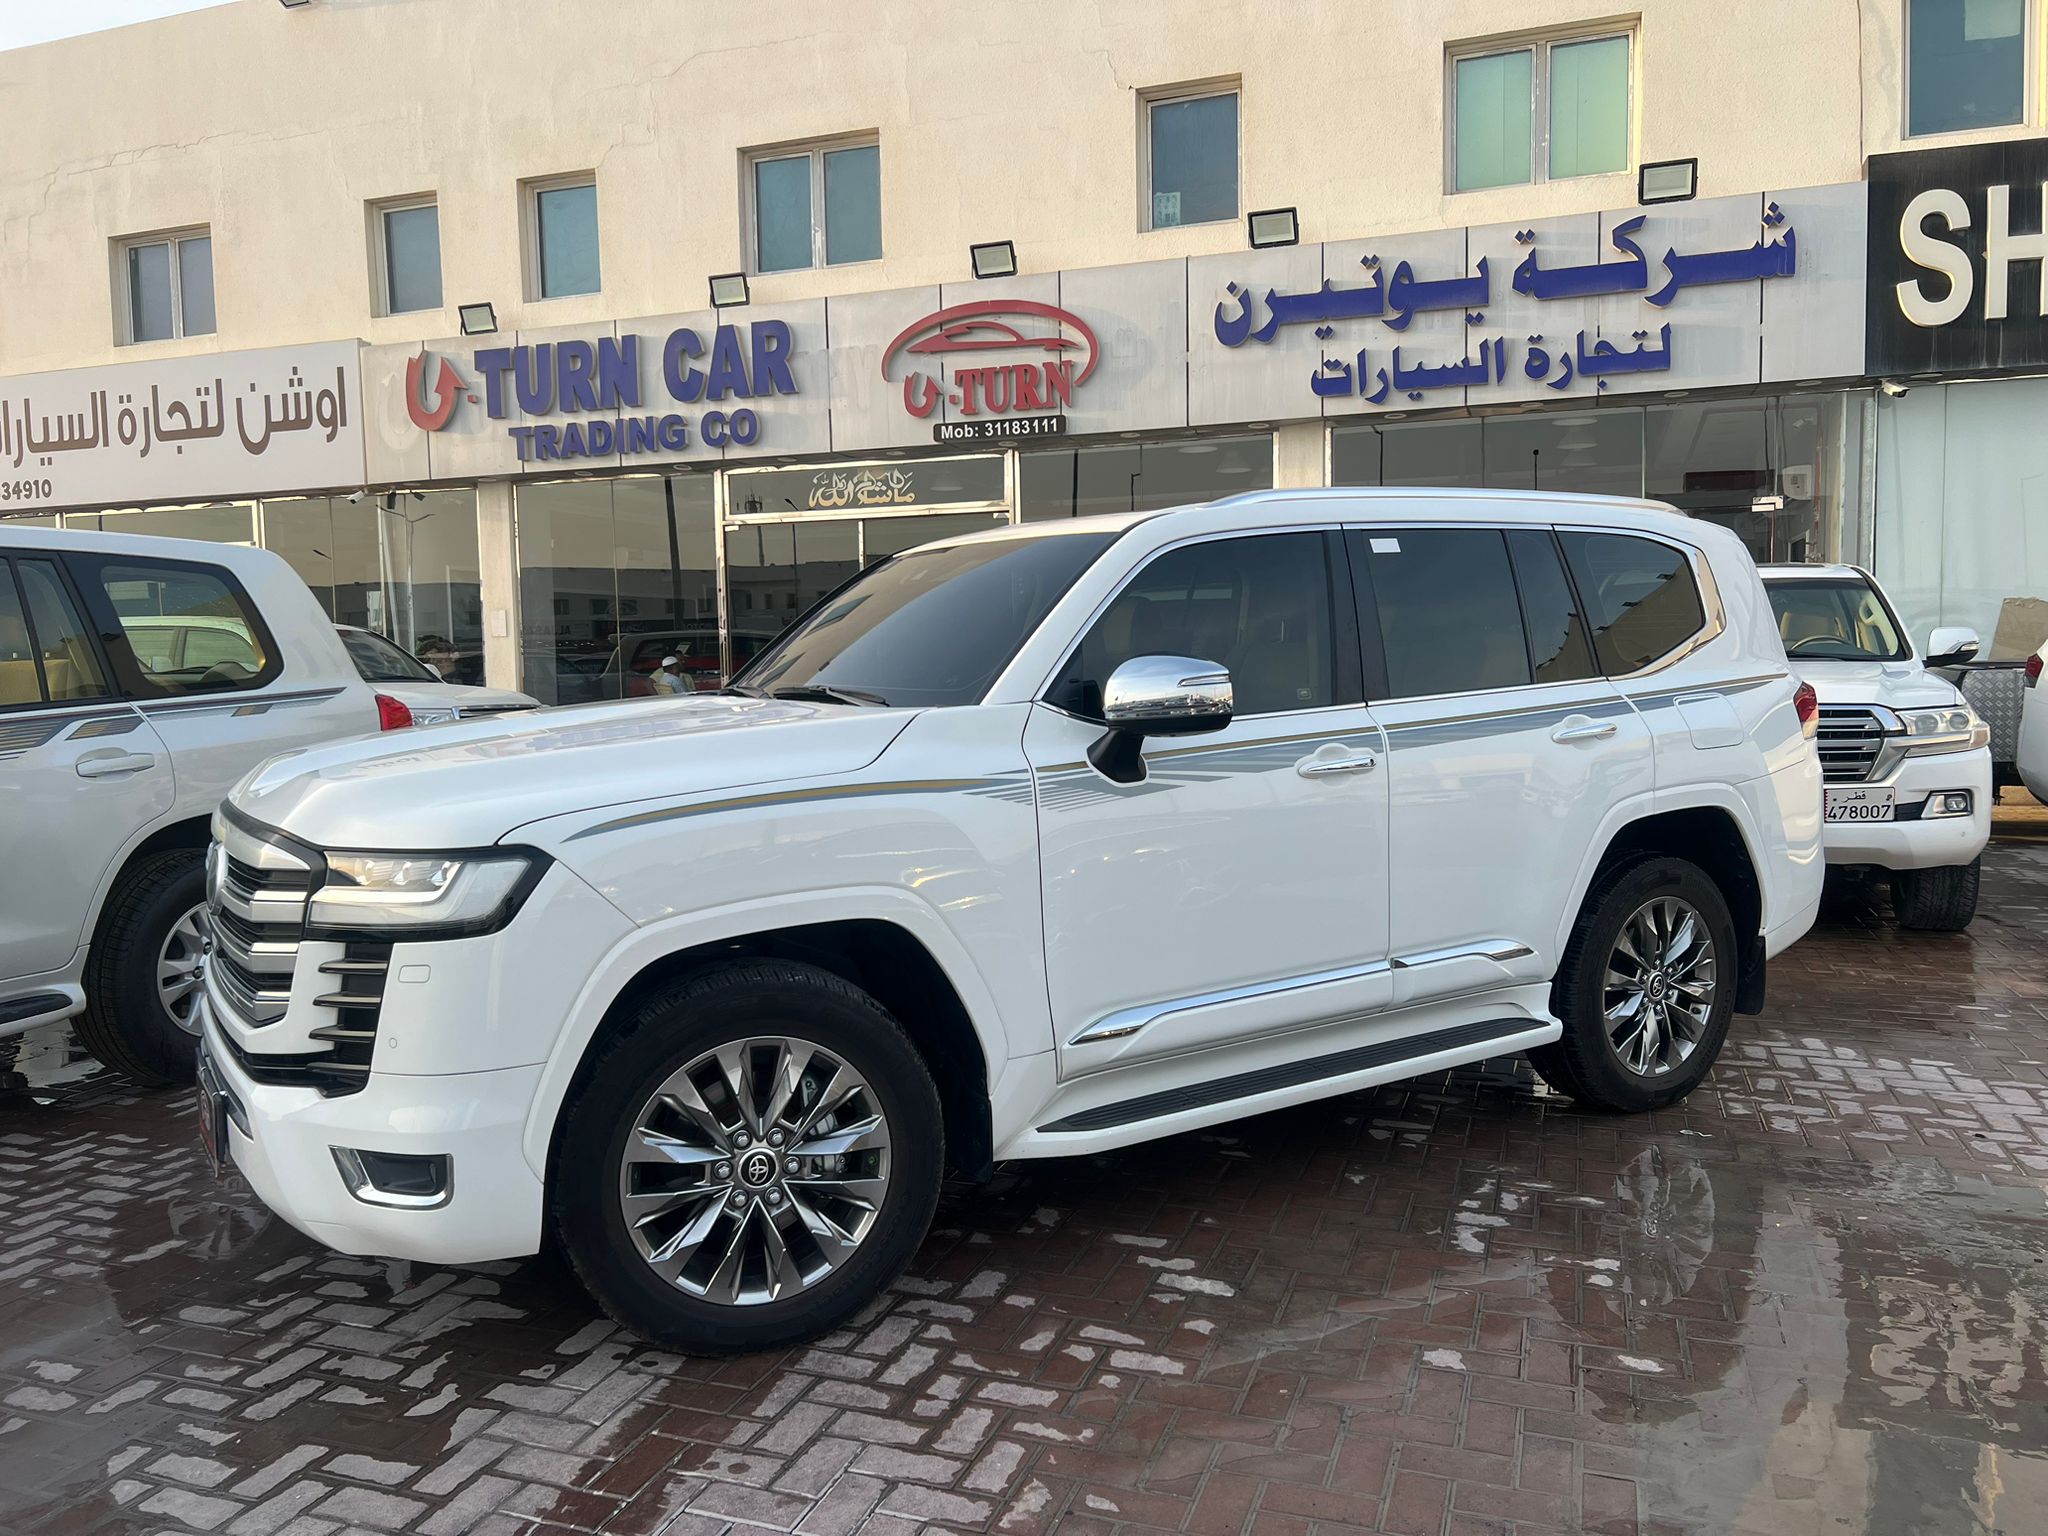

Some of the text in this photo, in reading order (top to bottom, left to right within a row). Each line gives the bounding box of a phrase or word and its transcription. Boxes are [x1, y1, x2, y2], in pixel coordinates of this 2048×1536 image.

[1214, 201, 1797, 348] شركة يوتيرن
[1896, 180, 2048, 328] SH
[663, 319, 800, 403] CAR
[1310, 321, 1672, 405] لتجارة السيارات
[0, 366, 348, 469] اوشن لتجارة السيارا
[508, 408, 761, 461] TRADING CO
[940, 417, 1058, 440] Mob: 31183111
[1827, 804, 1892, 820] 478007
